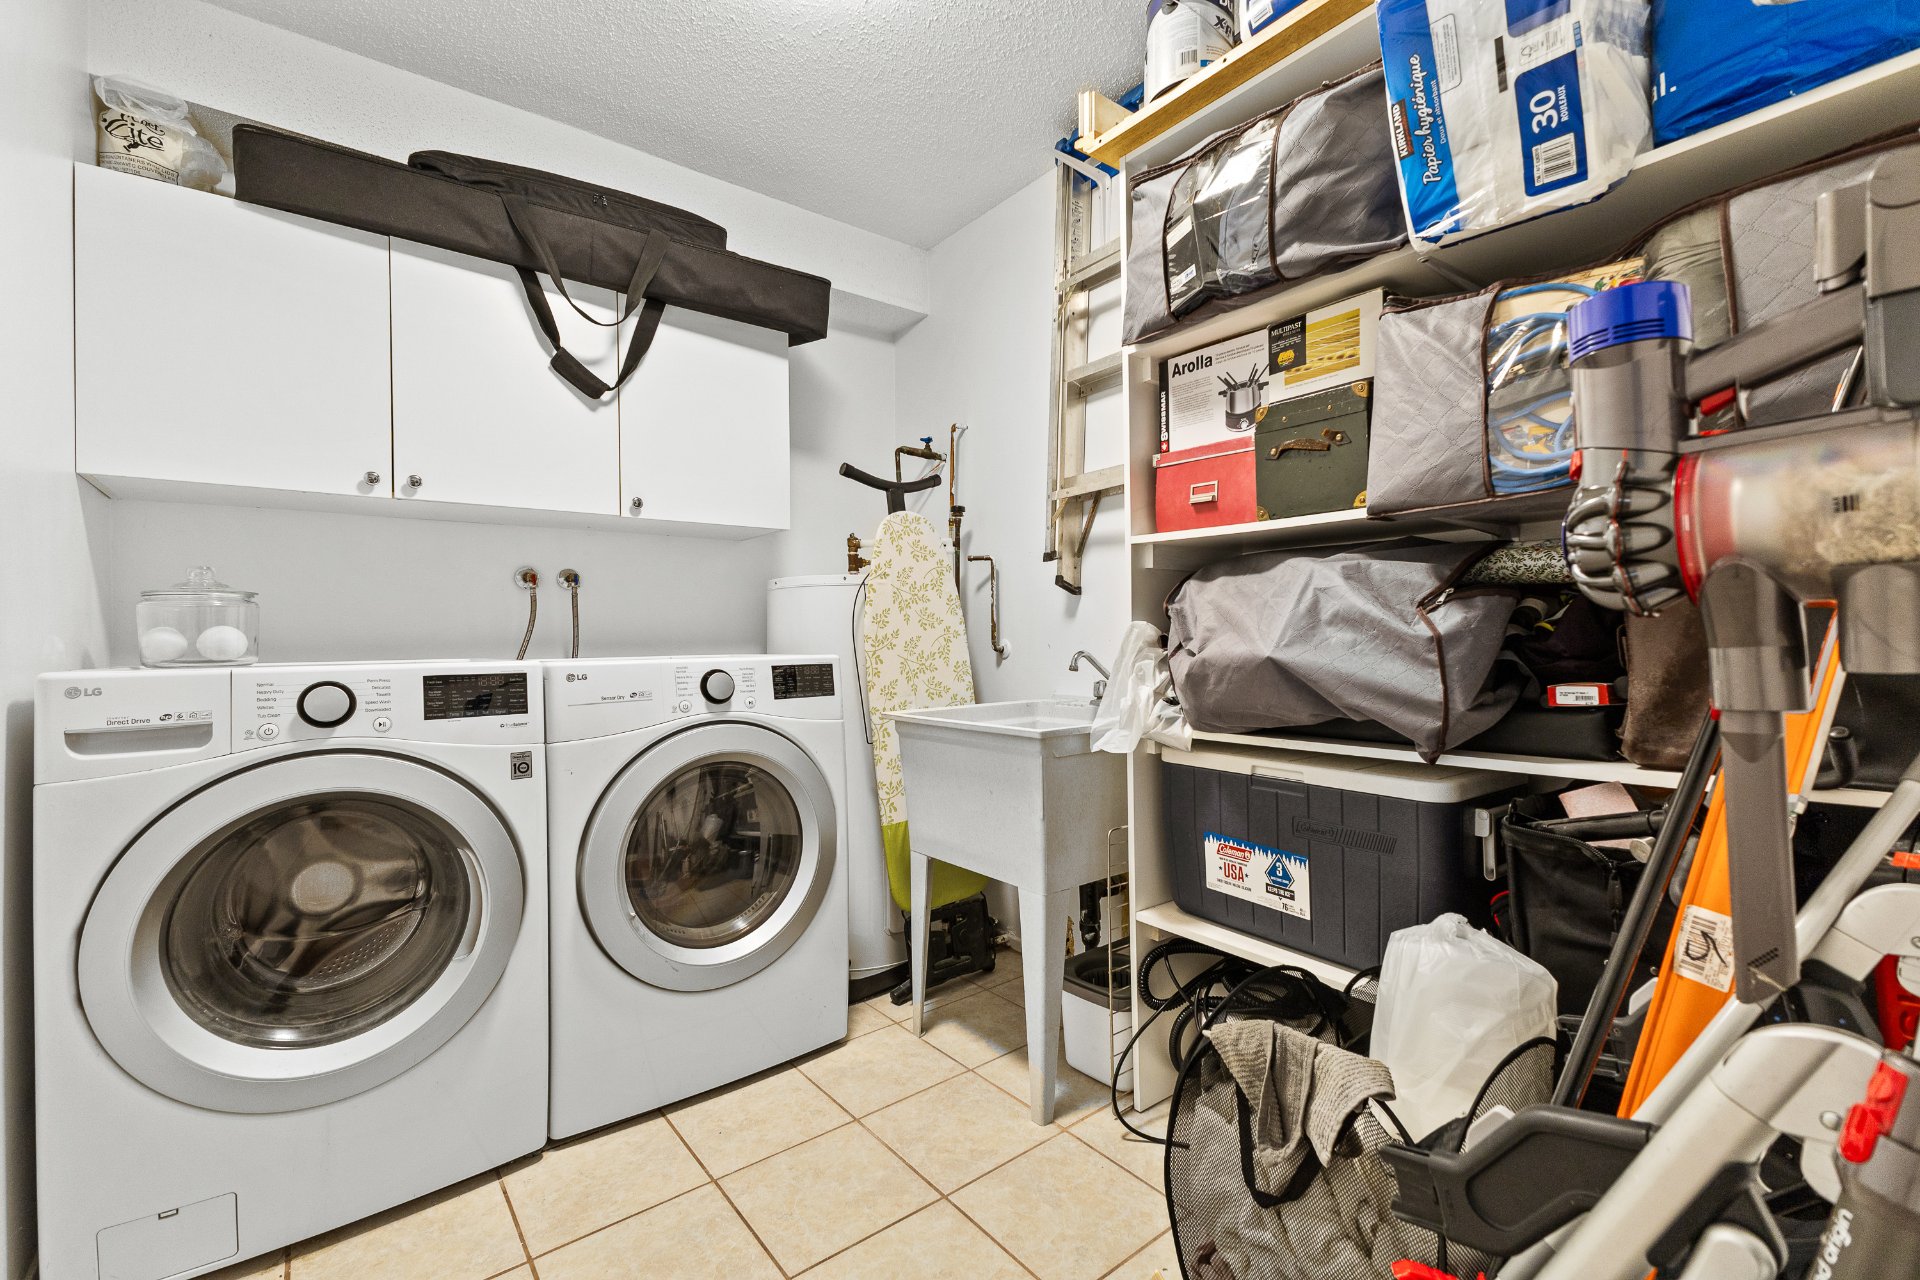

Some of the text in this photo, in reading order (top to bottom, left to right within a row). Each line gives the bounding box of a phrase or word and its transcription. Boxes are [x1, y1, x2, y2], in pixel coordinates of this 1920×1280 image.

[1557, 84, 1570, 122] ROULEAUX
[1409, 54, 1442, 185] Papier hygiénique
[1437, 116, 1443, 124] et
[1529, 90, 1559, 134] 30
[1392, 104, 1409, 157] KIRKLAND
[161, 168, 175, 178] LIDS
[1271, 321, 1302, 337] MULTIPAST
[1172, 354, 1213, 378] Arolla
[1160, 391, 1168, 442] SWISSMAR
[83, 687, 103, 697] LG
[106, 717, 151, 726] Direct Drive
[513, 762, 530, 774] 10
[1218, 844, 1245, 859] Coleman
[1223, 861, 1245, 882] USA
[1275, 861, 1283, 877] 3
